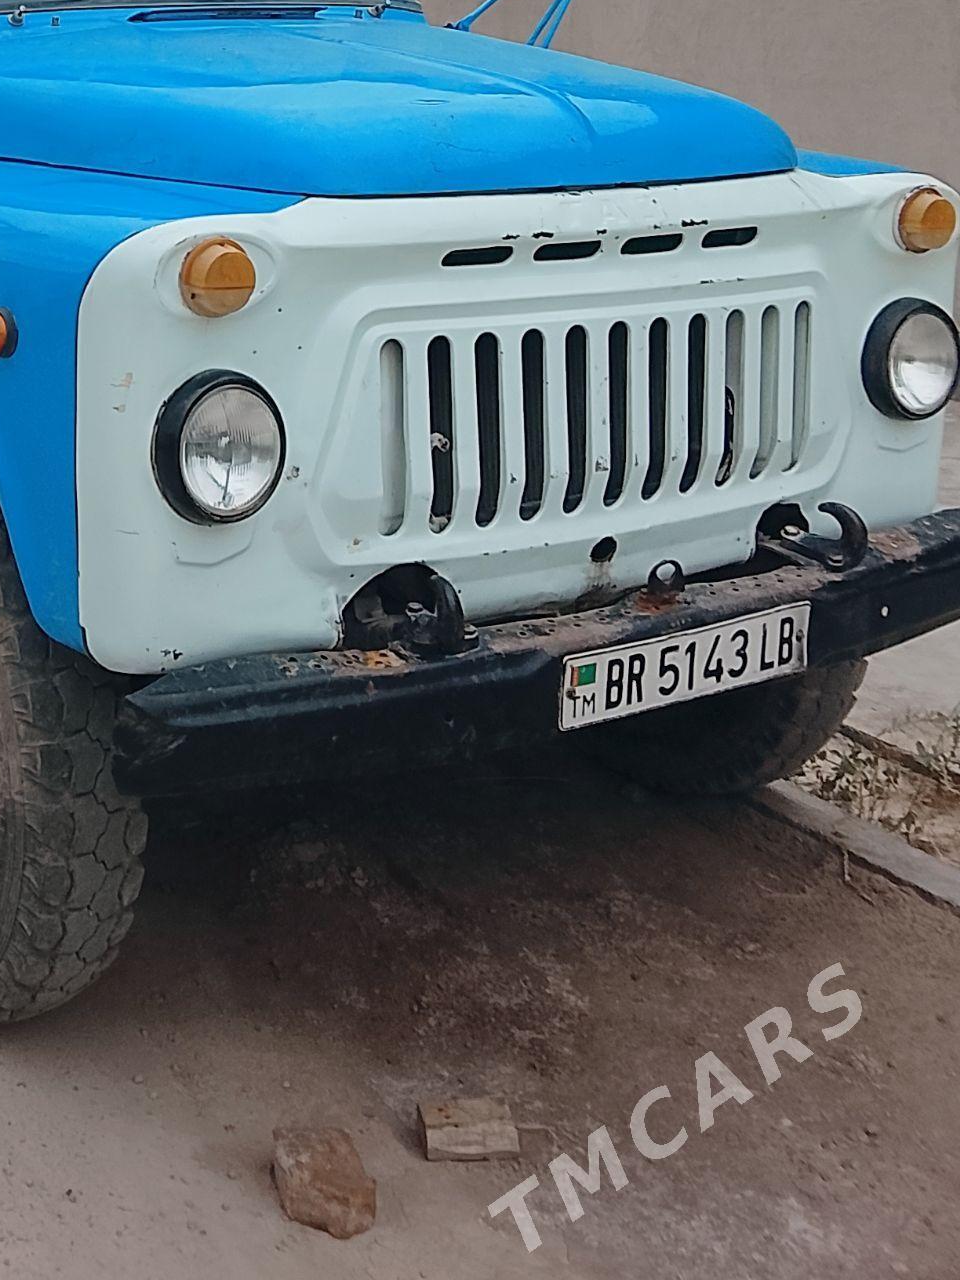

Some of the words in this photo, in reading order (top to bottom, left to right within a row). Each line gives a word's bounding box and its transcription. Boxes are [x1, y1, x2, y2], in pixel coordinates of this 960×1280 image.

[604, 653, 646, 710] BR
[657, 629, 749, 696] 5143
[759, 616, 795, 671] LB
[570, 692, 596, 718] TM
